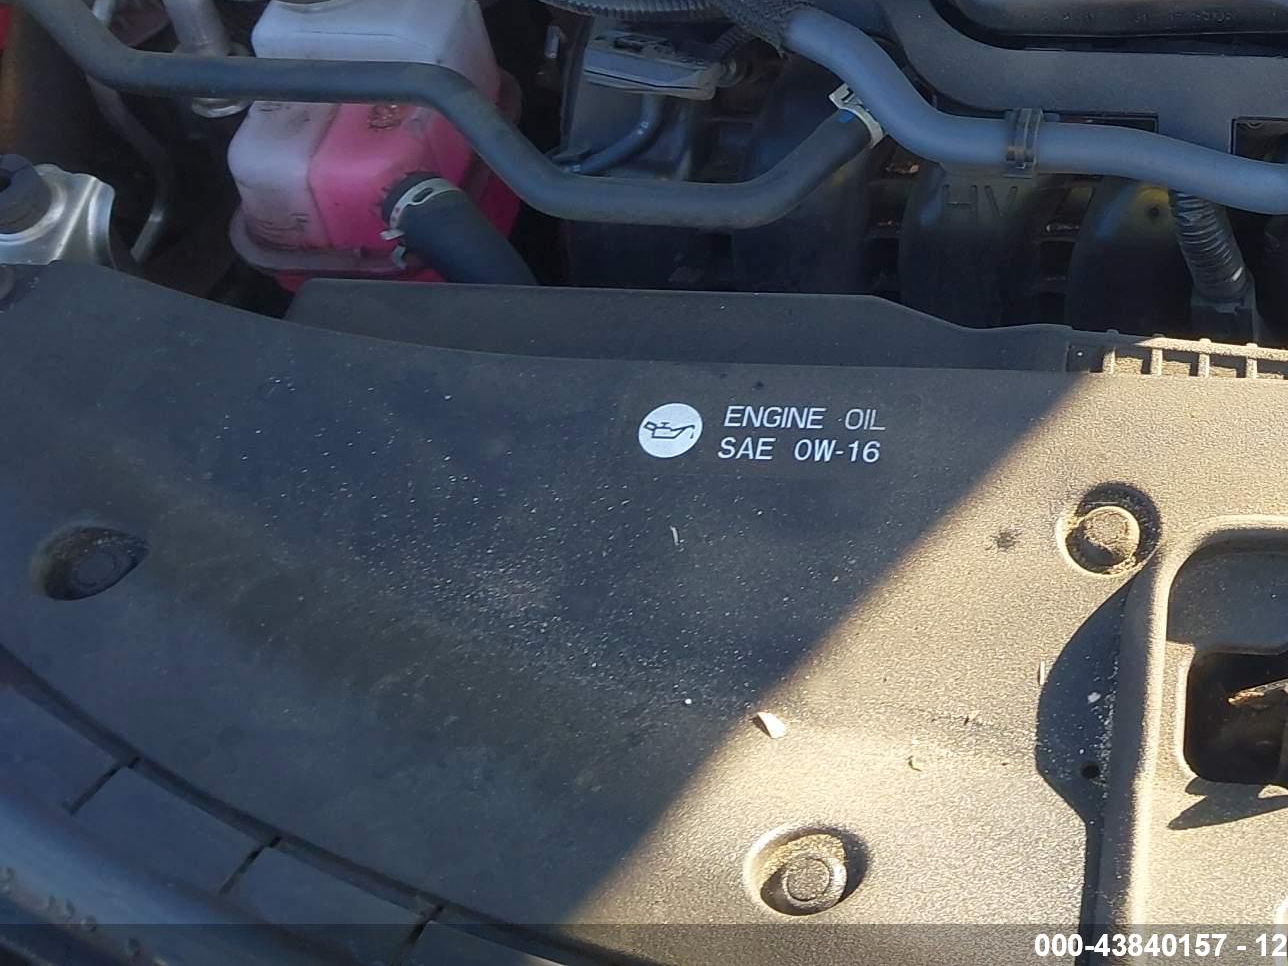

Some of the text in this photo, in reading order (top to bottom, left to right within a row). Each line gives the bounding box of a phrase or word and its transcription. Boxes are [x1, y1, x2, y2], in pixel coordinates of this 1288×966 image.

[723, 405, 886, 430] ENGINE OIL
[717, 436, 881, 463] SAE 0W-16
